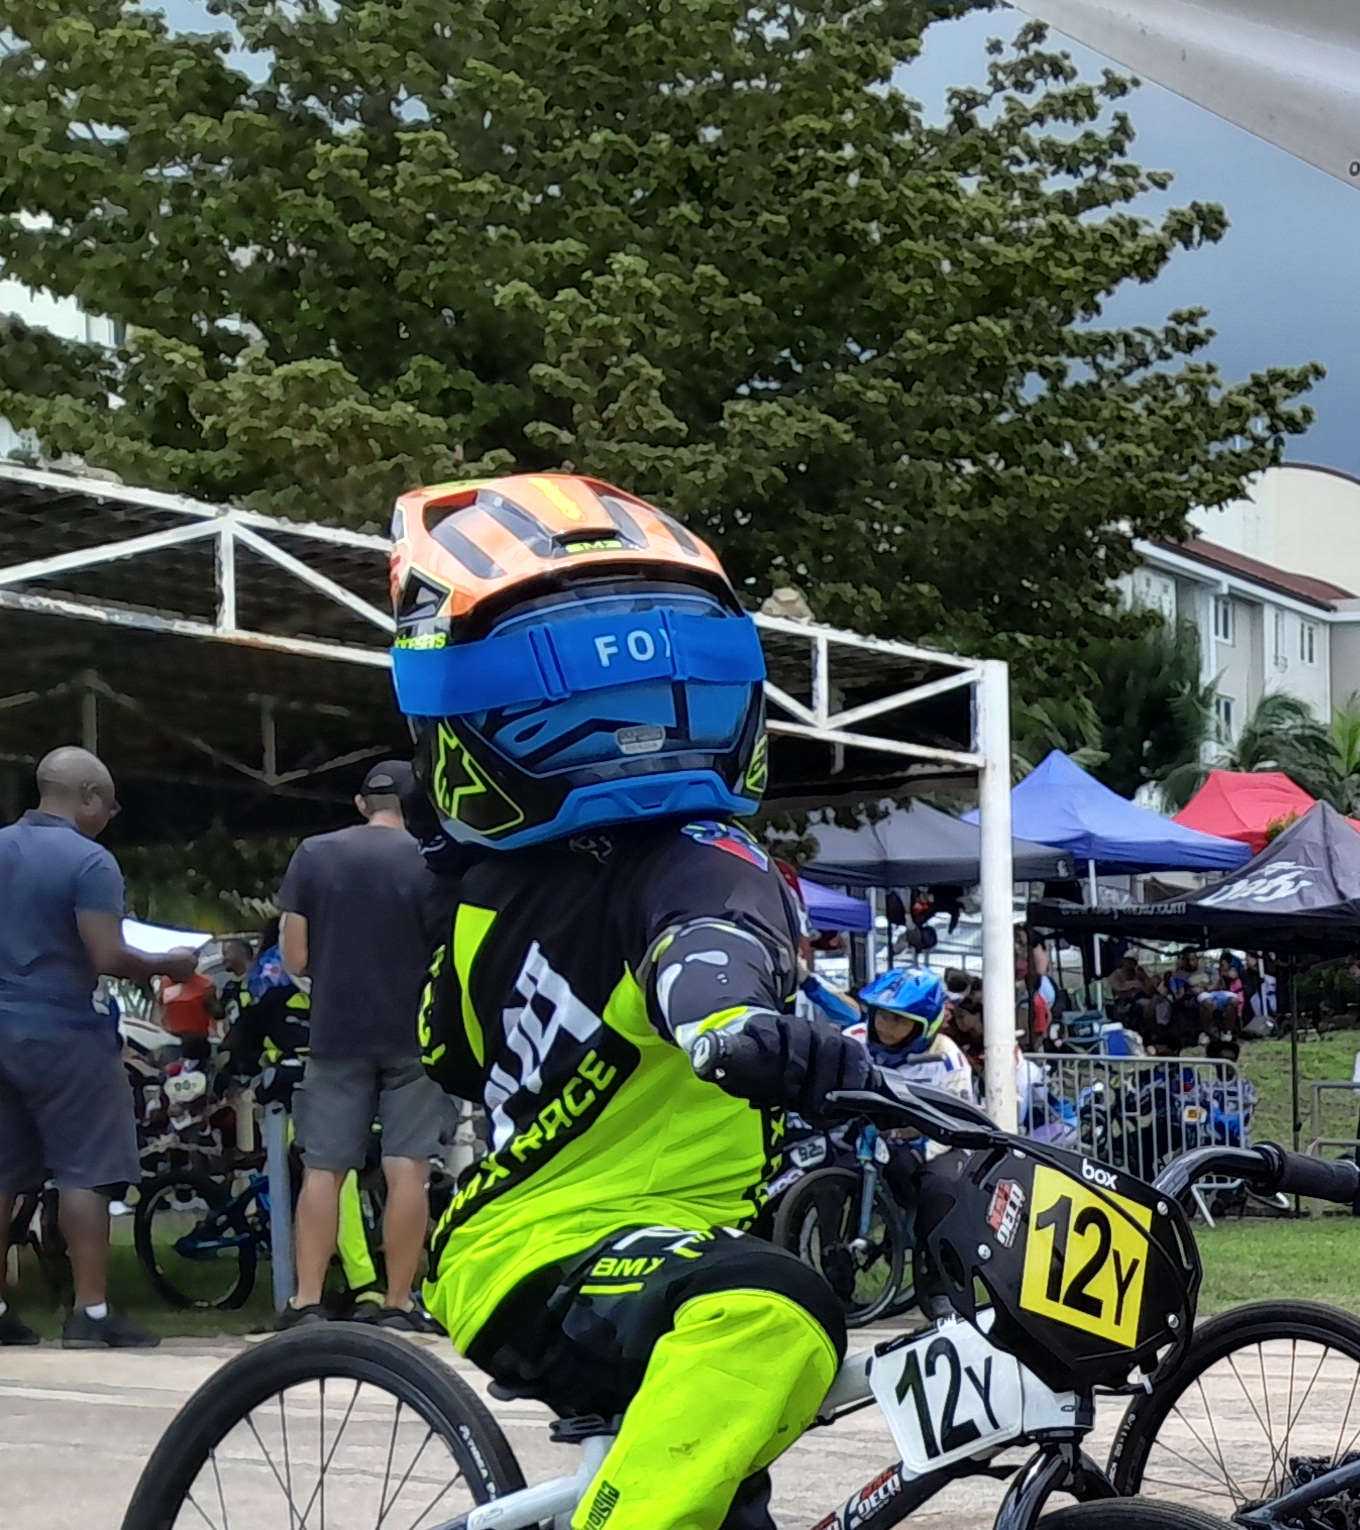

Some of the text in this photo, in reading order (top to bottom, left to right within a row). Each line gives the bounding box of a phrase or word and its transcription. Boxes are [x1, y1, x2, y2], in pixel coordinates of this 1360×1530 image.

[510, 1048, 618, 1163] RACE
[1082, 1158, 1118, 1190] box
[1035, 1194, 1140, 1327] 12Y
[895, 1336, 1000, 1461] 12Y
